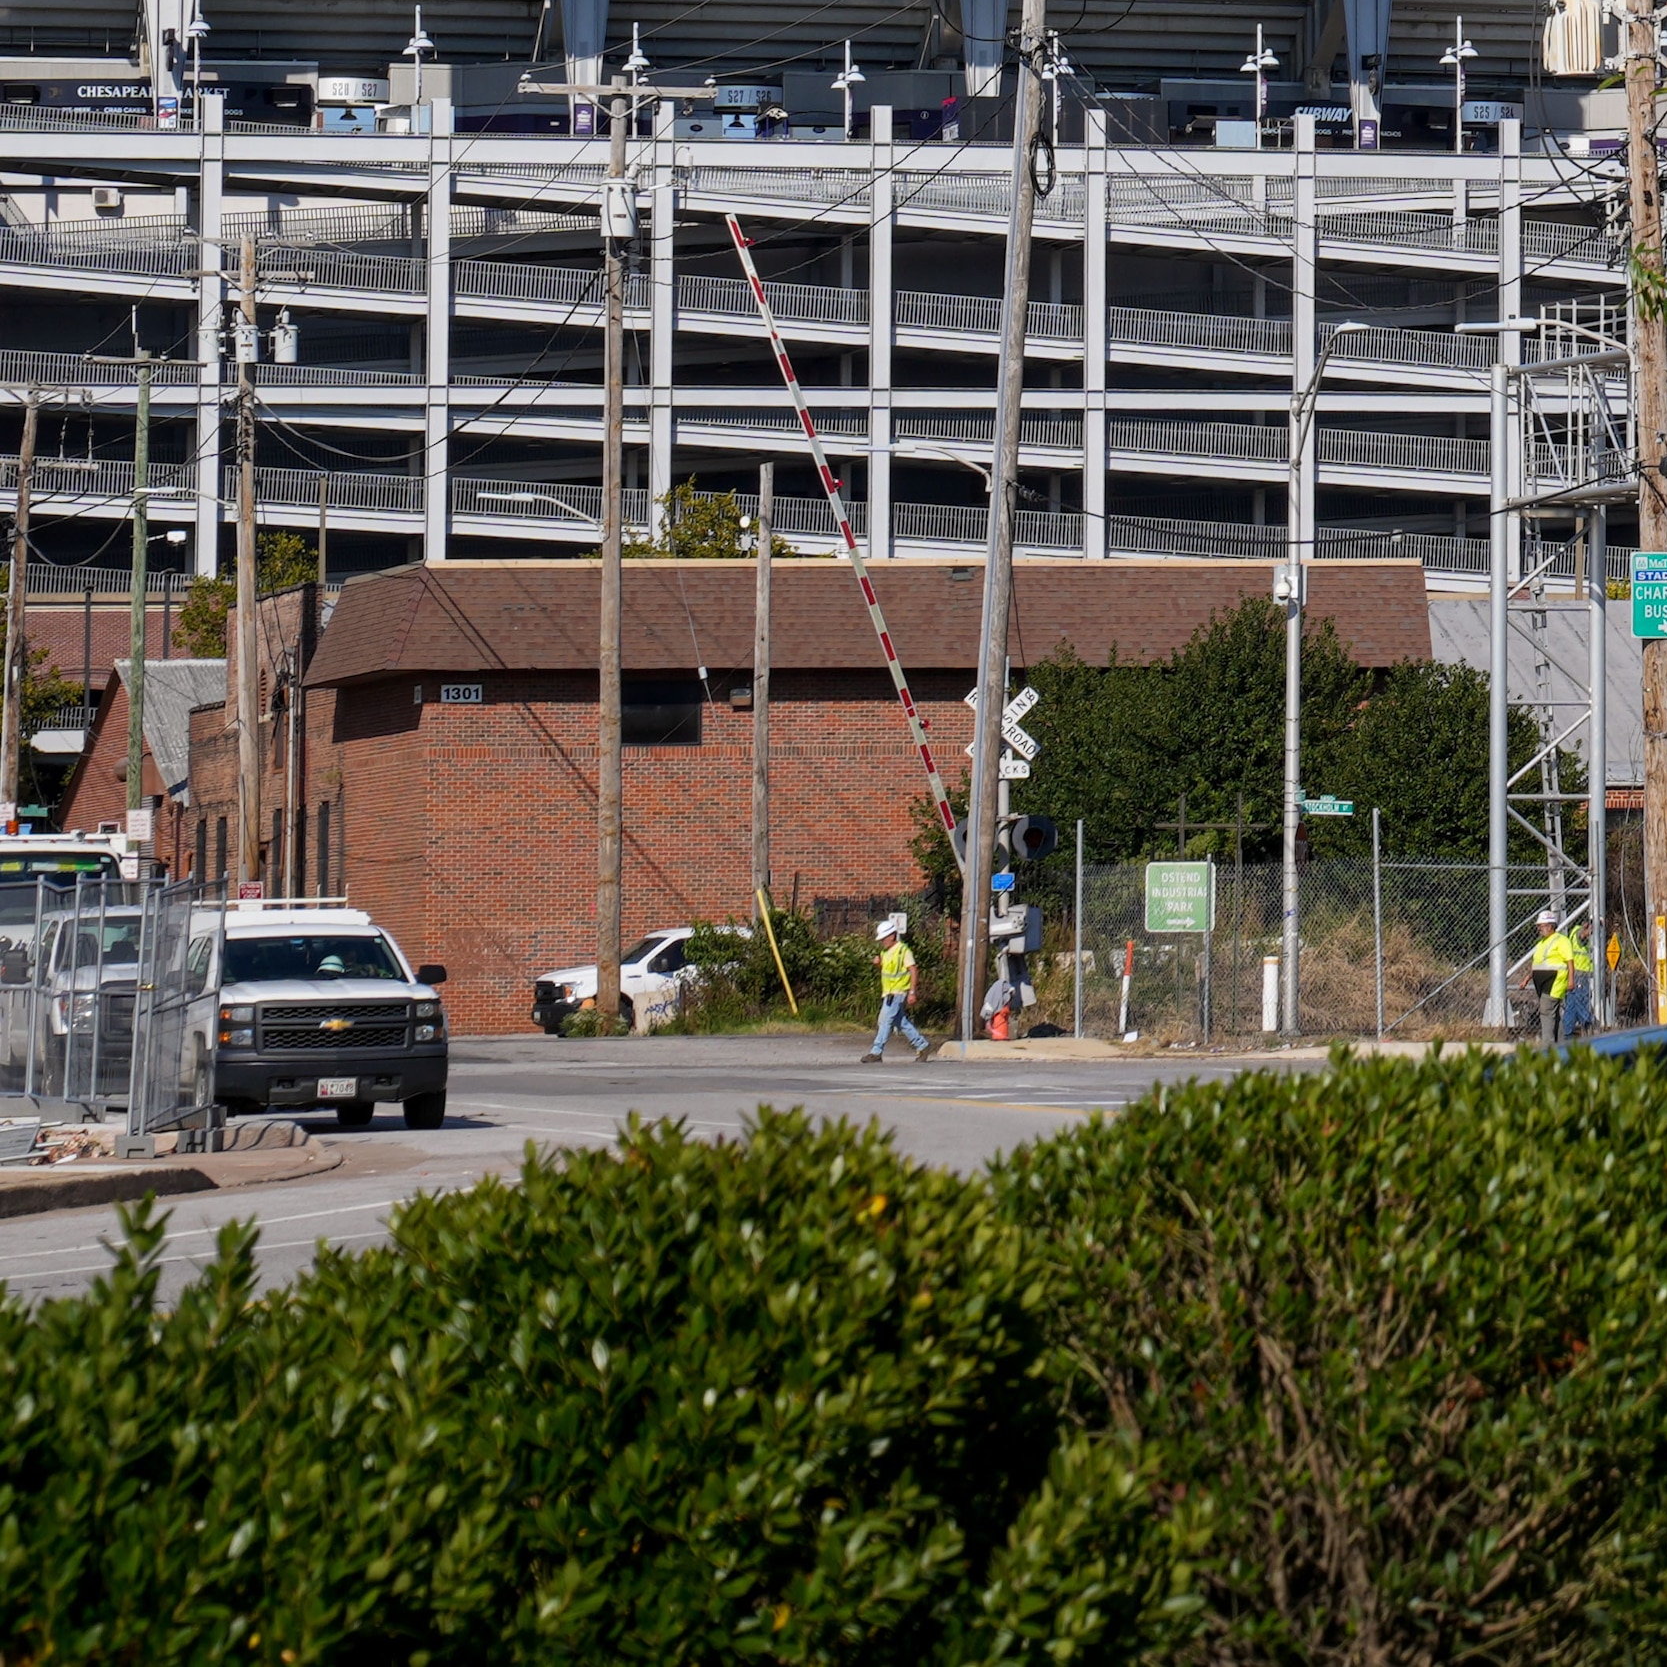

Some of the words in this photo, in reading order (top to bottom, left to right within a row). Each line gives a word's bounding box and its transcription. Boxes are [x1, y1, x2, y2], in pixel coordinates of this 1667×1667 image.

[77, 85, 154, 98] CHESAPEA
[183, 89, 230, 100] ARKET
[1290, 106, 1353, 122] SUBWAY
[444, 687, 480, 700] 1301
[1005, 726, 1037, 755] ROAD
[1161, 871, 1201, 883] OSTEND
[1166, 901, 1194, 912] PARK
